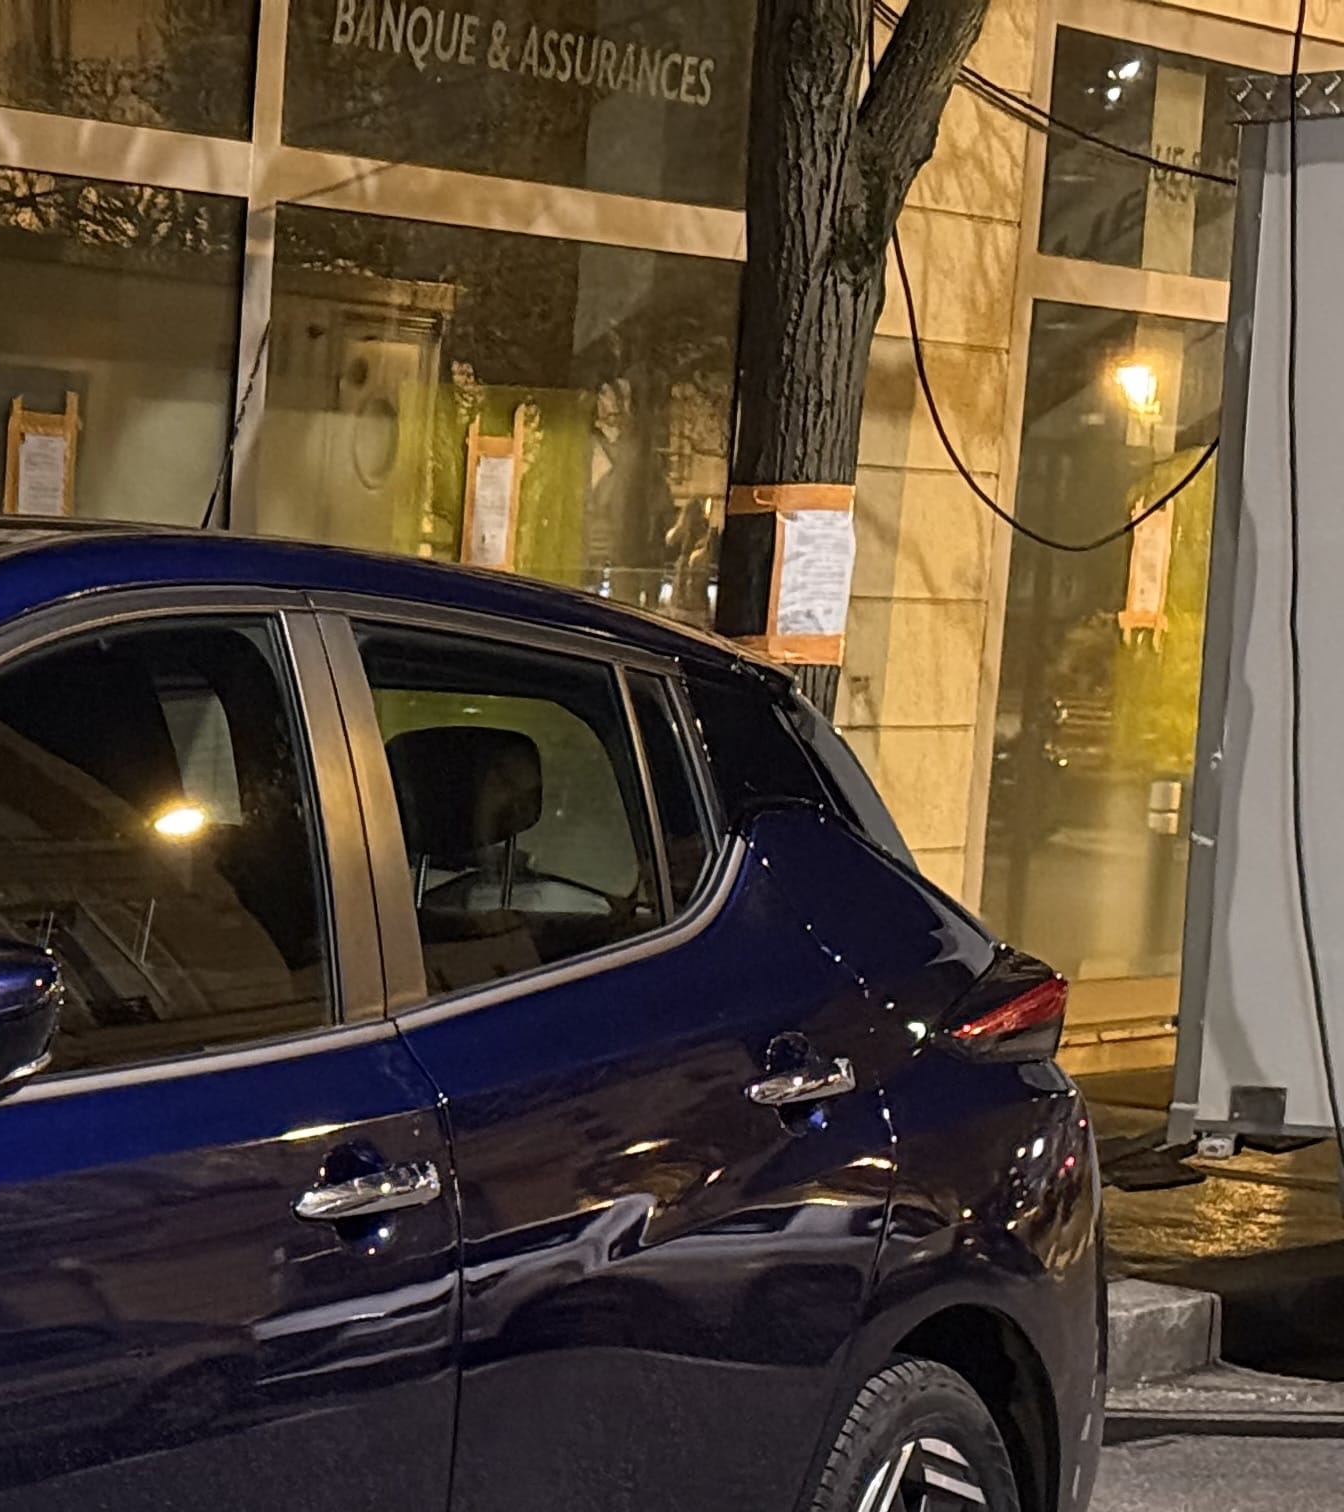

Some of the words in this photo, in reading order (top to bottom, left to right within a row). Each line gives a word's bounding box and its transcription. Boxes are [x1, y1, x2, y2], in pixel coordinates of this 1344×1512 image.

[332, 0, 480, 71] BANQUE
[486, 20, 510, 71] &
[520, 26, 714, 107] ASSURANCES
